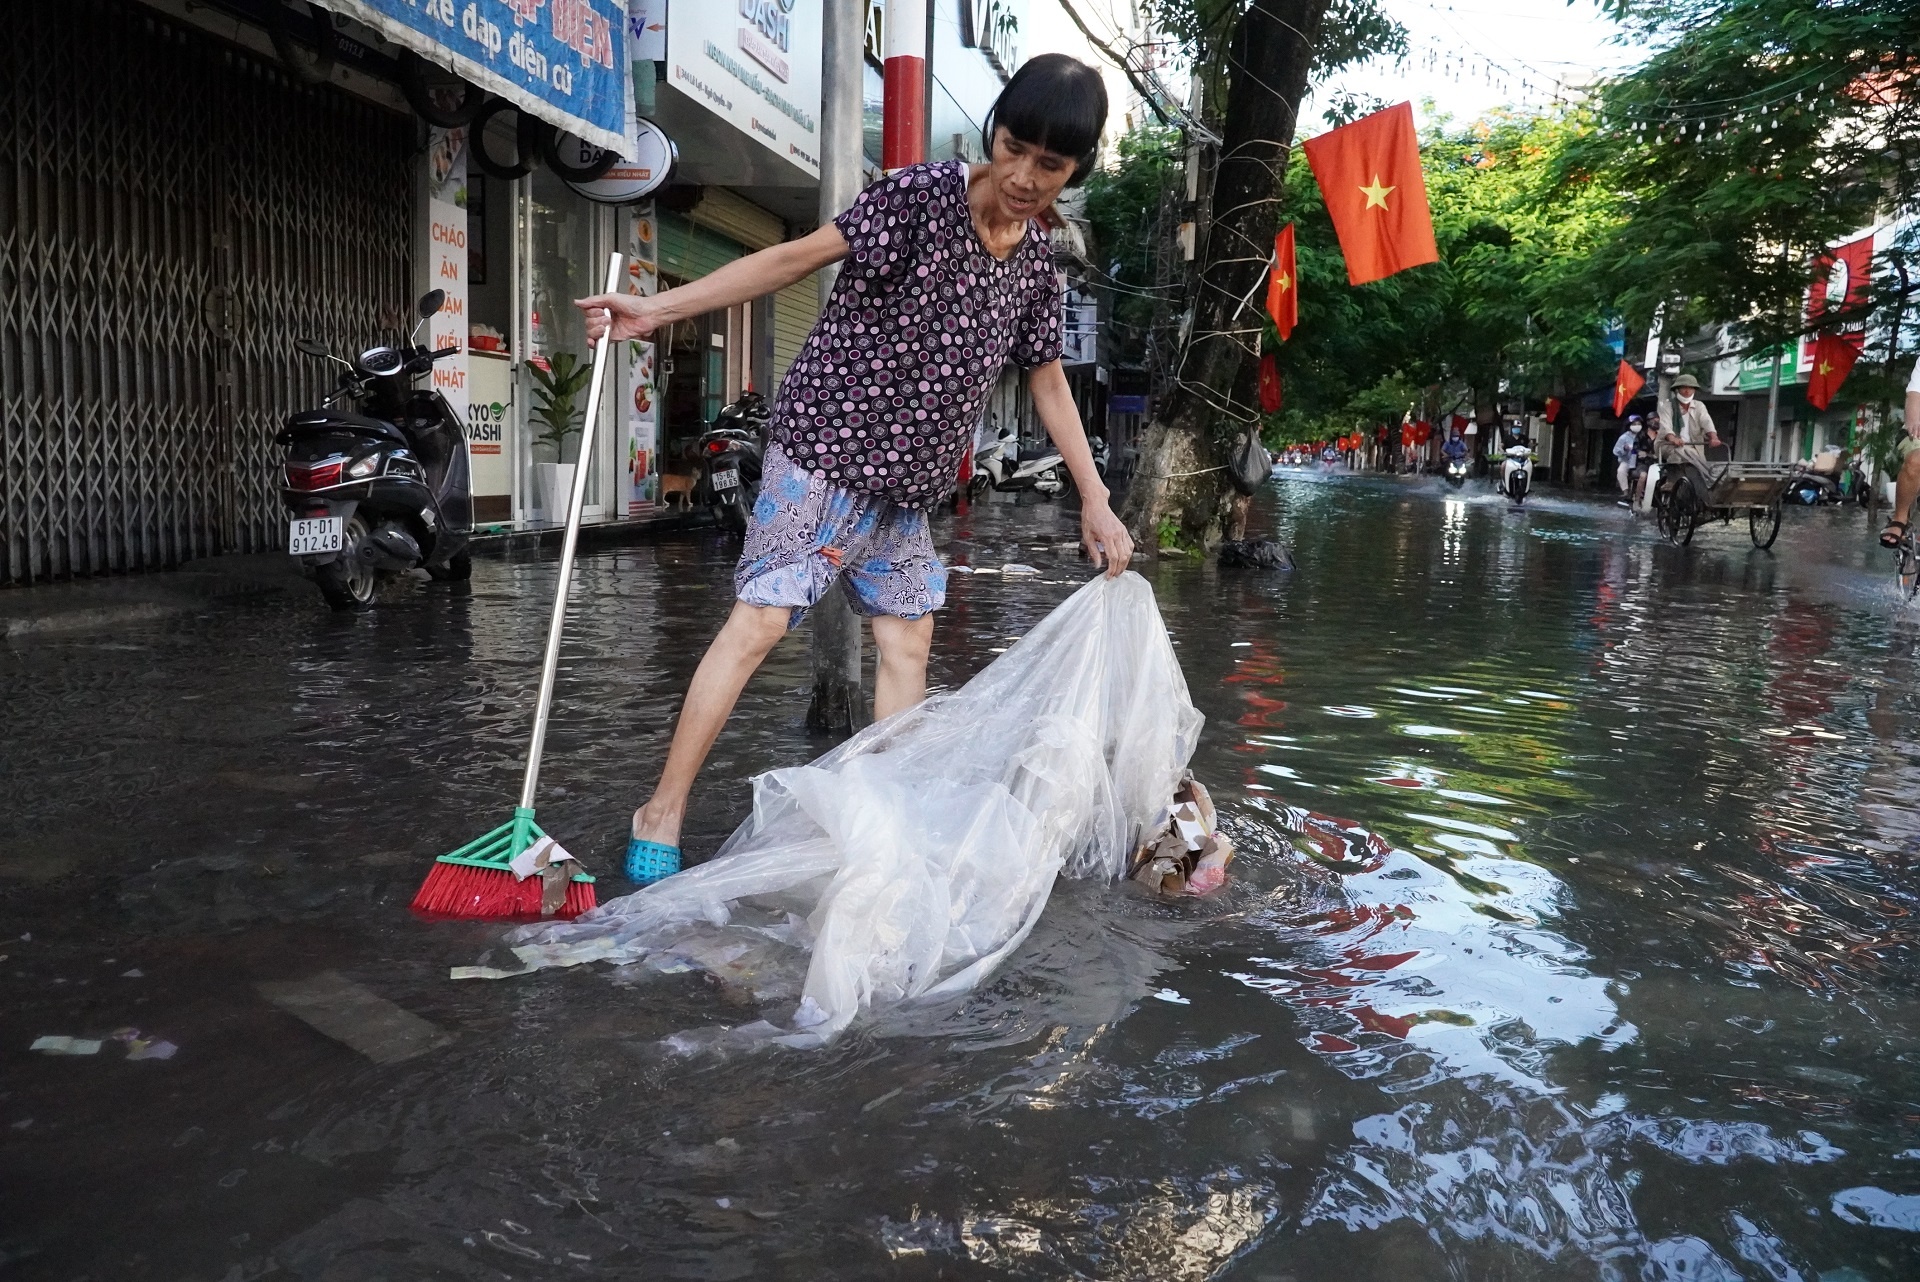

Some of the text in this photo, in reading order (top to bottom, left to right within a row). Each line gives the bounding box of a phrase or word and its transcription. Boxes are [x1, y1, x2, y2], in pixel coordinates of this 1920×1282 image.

[426, 0, 454, 27] xe
[463, 3, 501, 60] đạp
[509, 31, 548, 83] điện
[552, 0, 613, 69] ĐIỆN
[432, 223, 465, 249] CHÁO
[440, 255, 458, 281] ĂN
[434, 367, 466, 393] NHẬT
[298, 519, 333, 536] 61-D1
[293, 535, 338, 552] 912.48
